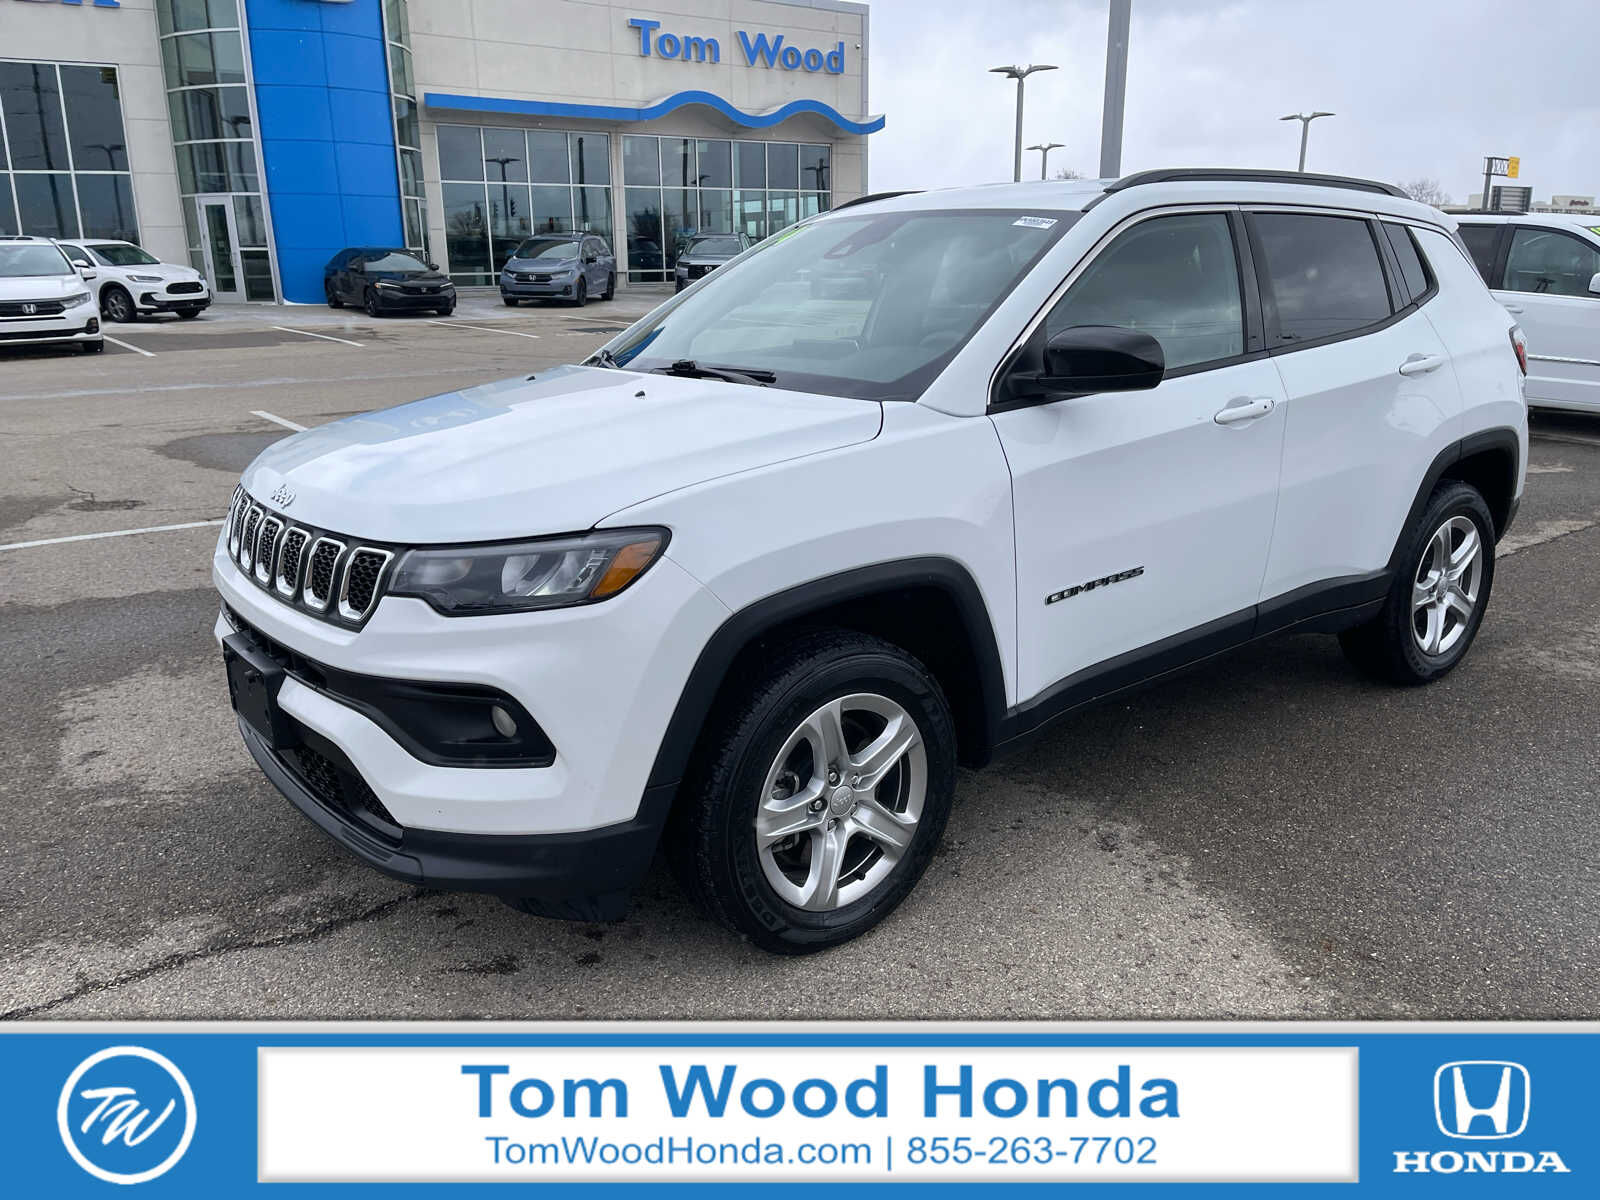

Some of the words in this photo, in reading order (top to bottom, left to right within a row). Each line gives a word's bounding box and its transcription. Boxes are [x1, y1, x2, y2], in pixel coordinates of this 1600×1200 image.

[628, 18, 720, 63] Tom
[737, 31, 845, 74] Wood
[1045, 566, 1145, 605] COMPASS
